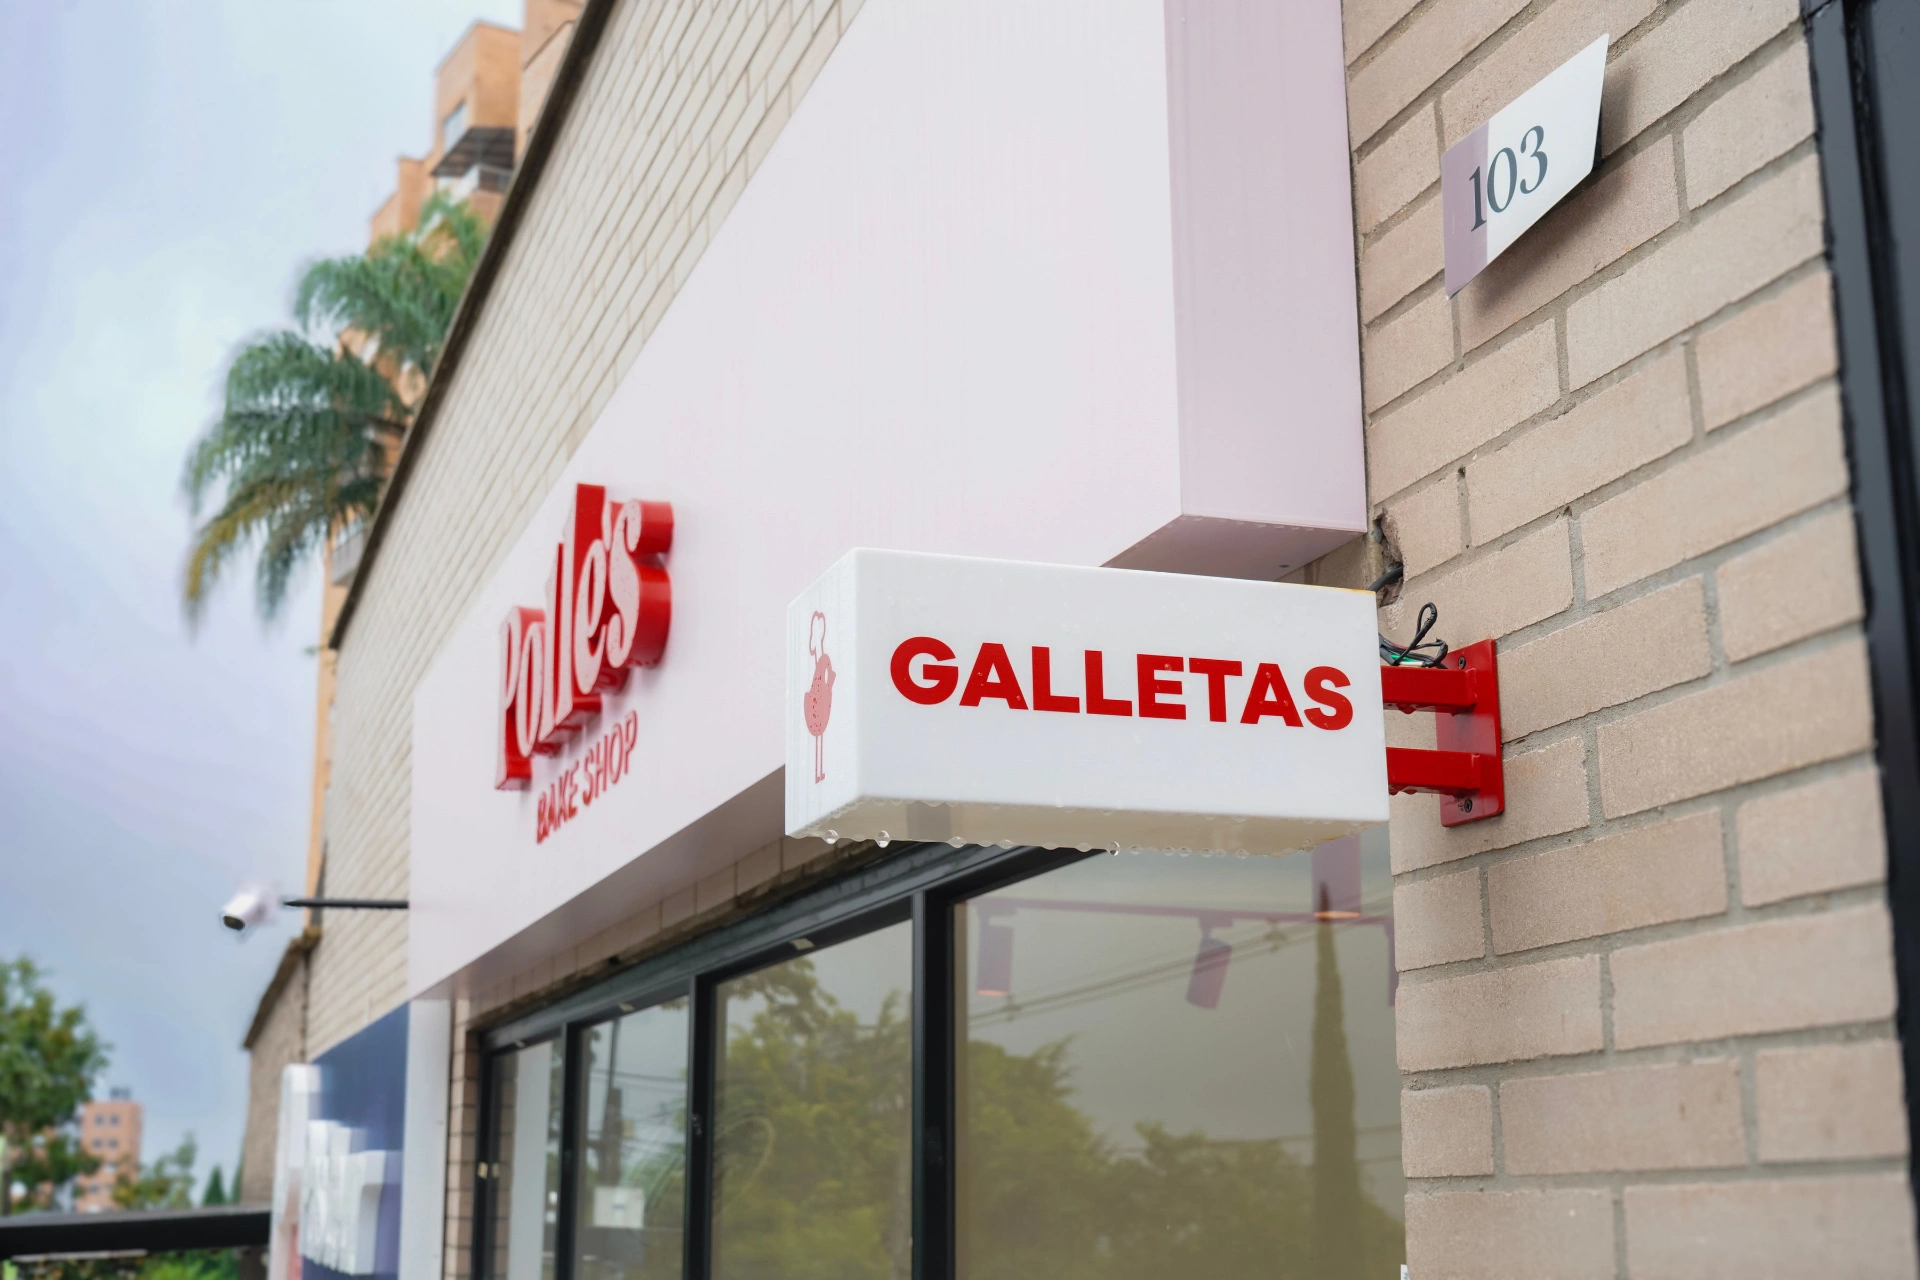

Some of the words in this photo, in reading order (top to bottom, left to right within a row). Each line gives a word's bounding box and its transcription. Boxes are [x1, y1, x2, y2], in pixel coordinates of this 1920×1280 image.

[1469, 125, 1548, 232] 103
[890, 636, 1353, 730] GALLETAS
[536, 757, 580, 844] BAKE
[581, 708, 638, 806] SHOP
